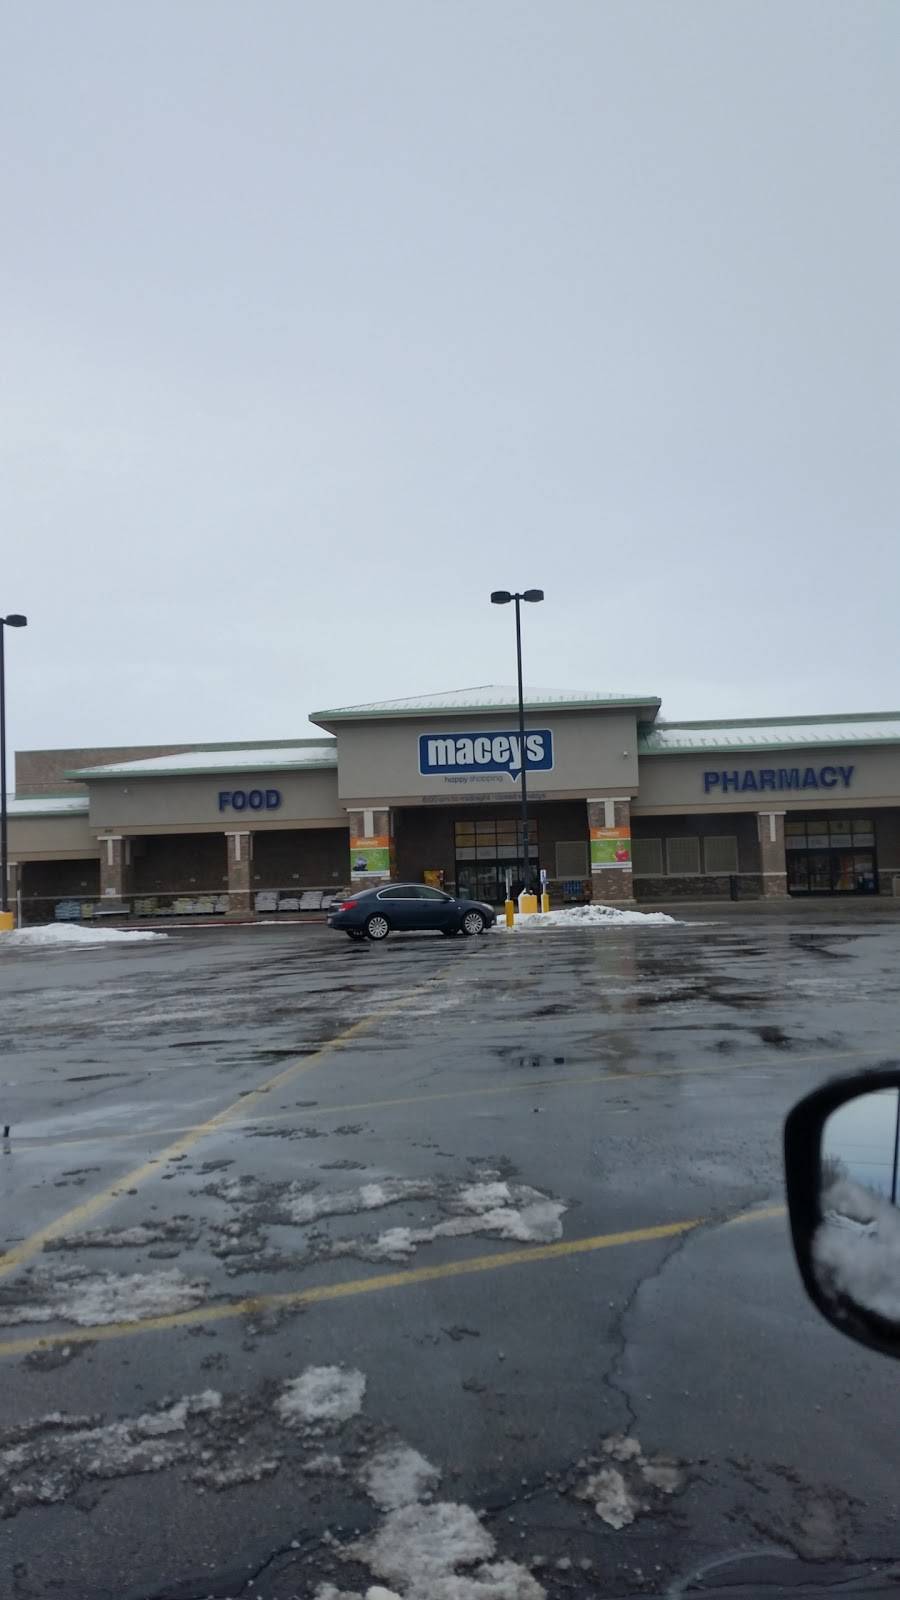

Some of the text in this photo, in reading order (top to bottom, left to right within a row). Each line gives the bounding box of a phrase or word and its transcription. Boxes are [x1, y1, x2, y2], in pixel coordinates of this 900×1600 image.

[428, 735, 545, 770] maceys
[445, 775, 504, 784] happy shopping
[703, 765, 855, 795] PHARMACY
[218, 789, 281, 812] FOOD
